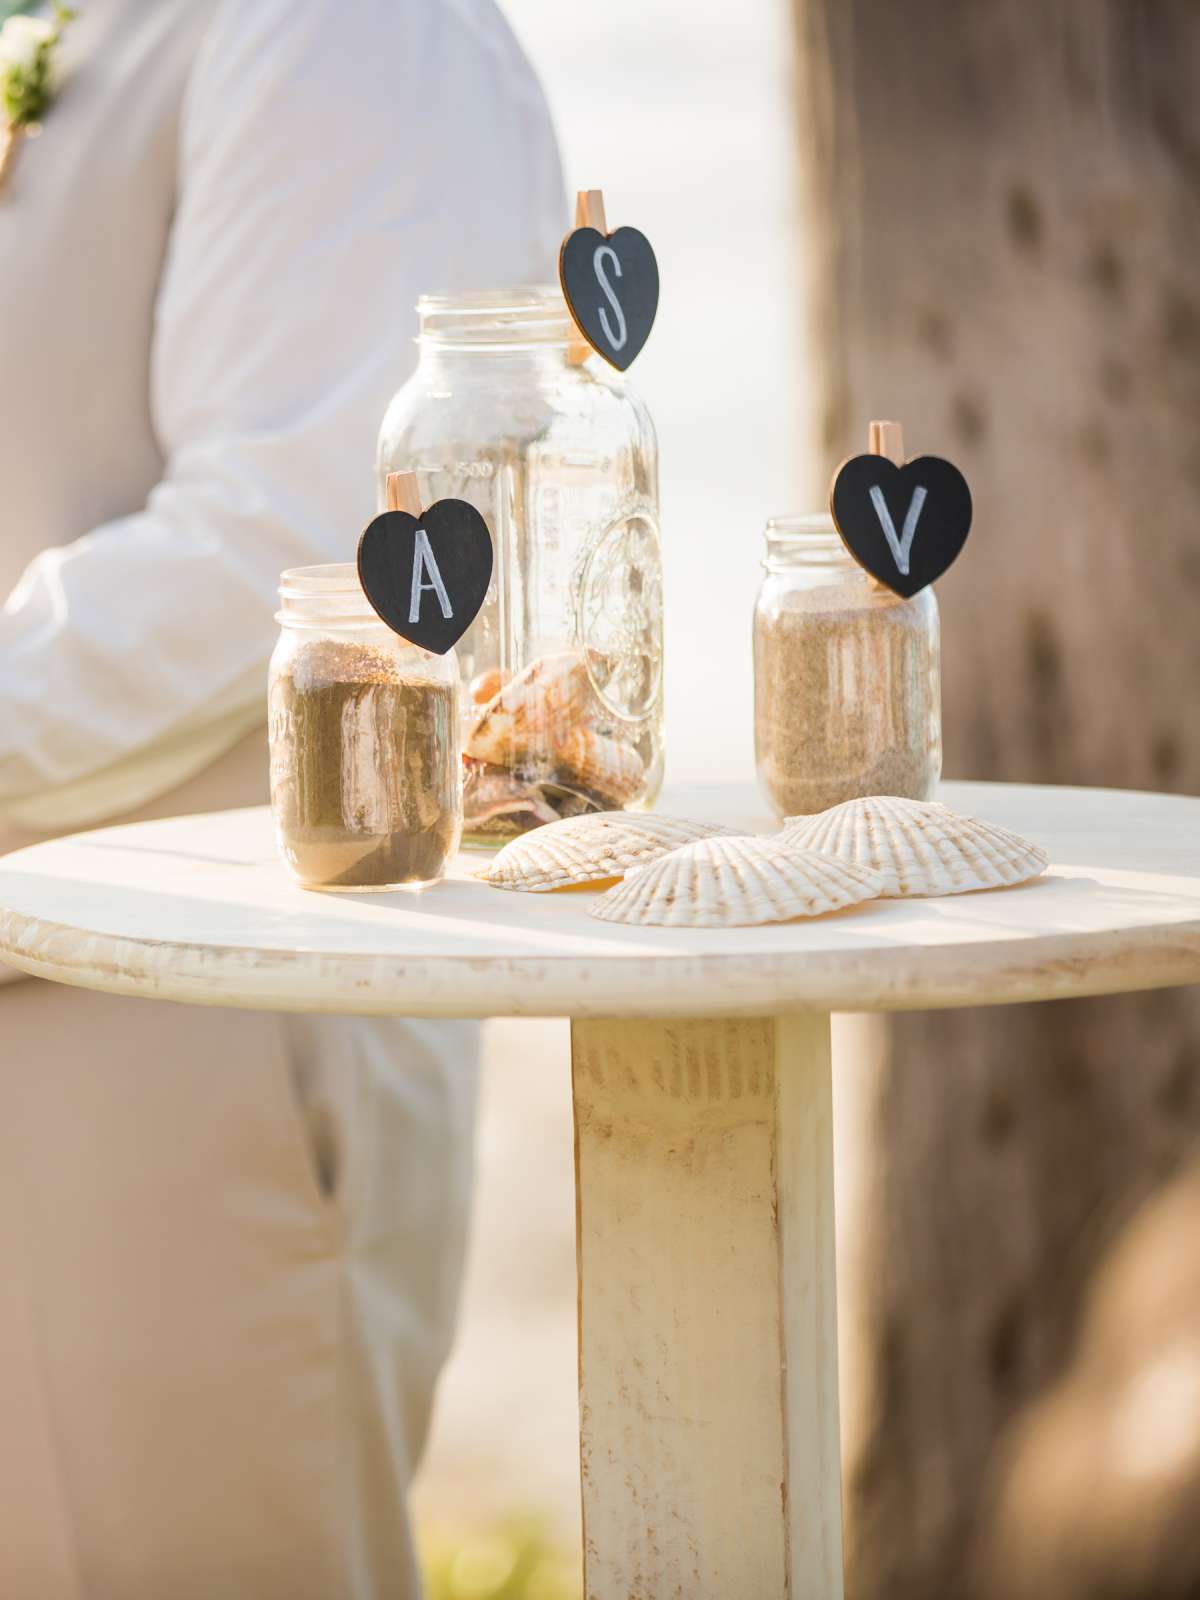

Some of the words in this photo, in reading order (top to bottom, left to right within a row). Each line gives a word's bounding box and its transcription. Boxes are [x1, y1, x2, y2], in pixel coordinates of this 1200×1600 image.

[593, 246, 628, 351] S
[409, 530, 454, 623] A
[870, 486, 927, 574] V
